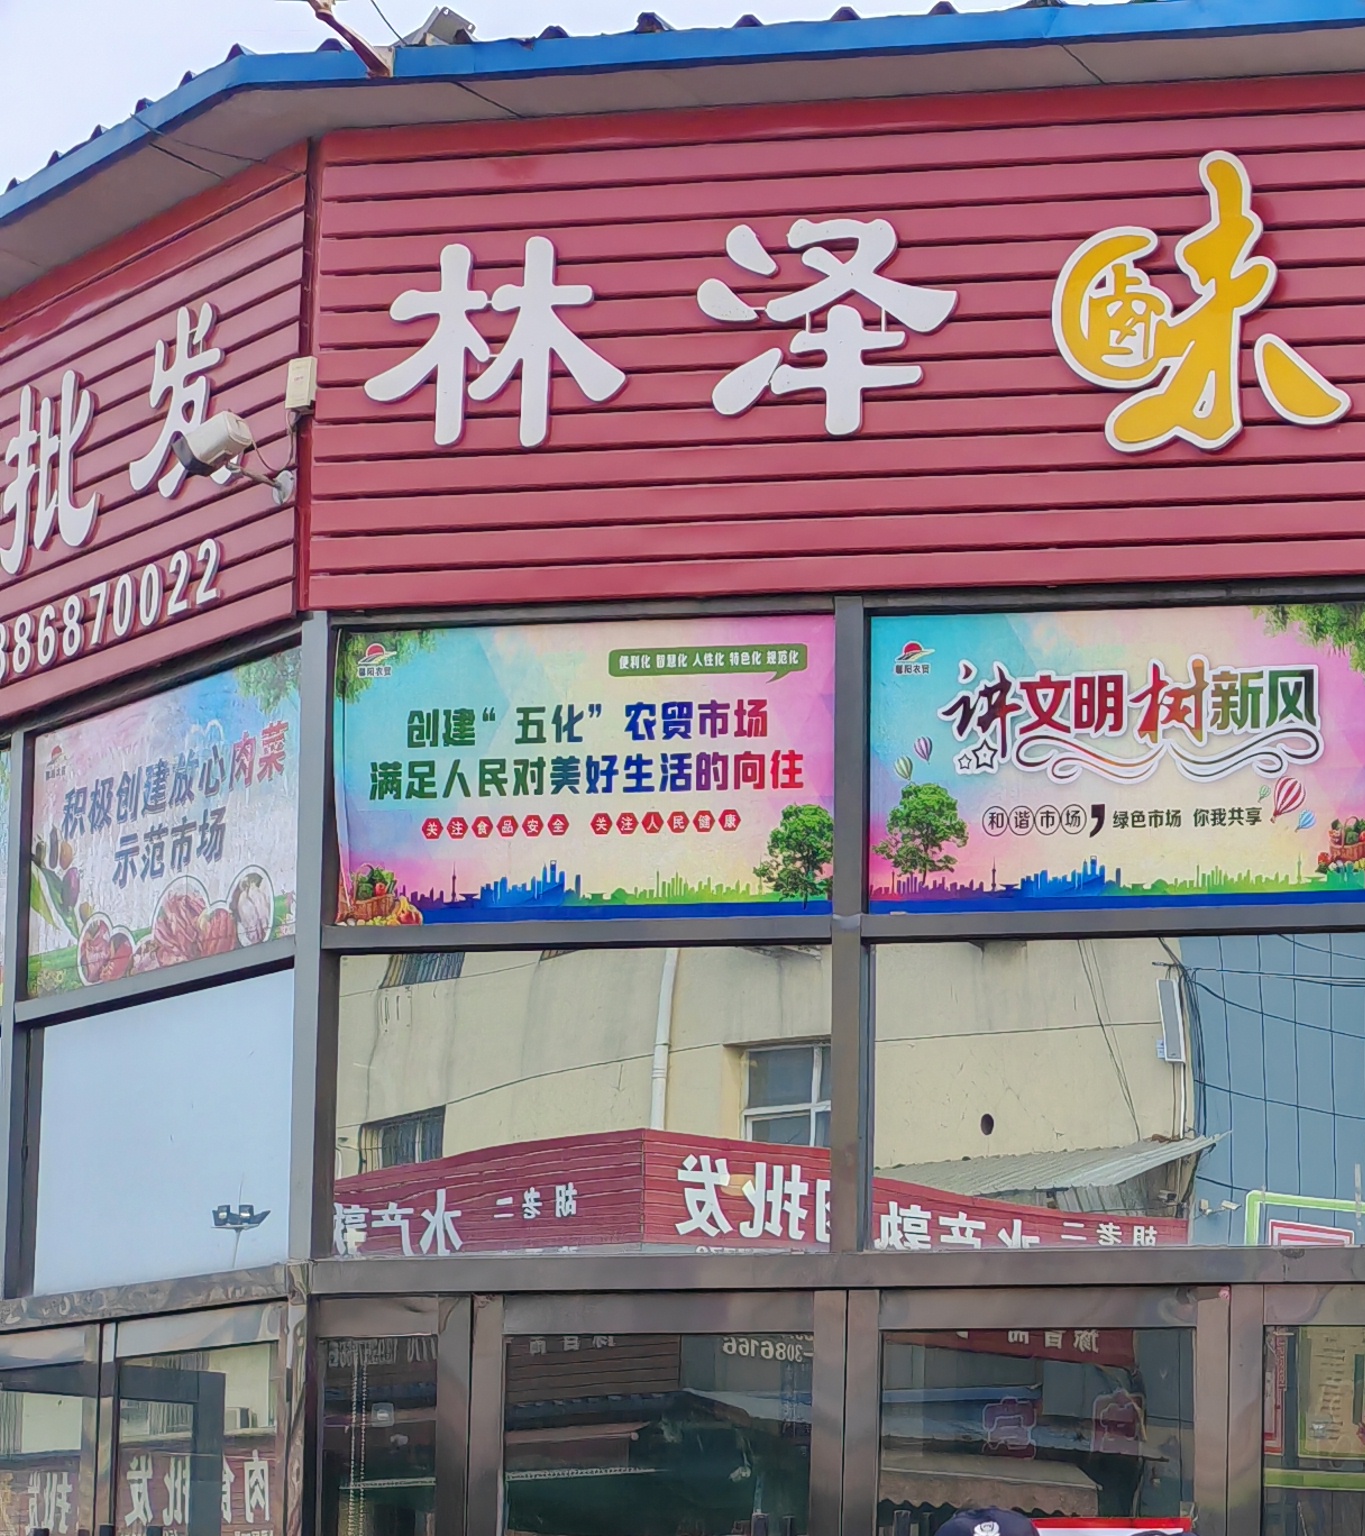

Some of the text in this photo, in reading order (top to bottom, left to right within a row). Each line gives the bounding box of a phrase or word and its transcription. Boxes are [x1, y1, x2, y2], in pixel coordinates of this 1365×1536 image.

[0, 302, 246, 576] 批发
[618, 649, 799, 671] 便利化 智慧化 人性化 特色化 规范化
[941, 660, 1319, 758] 讲文明树新风
[61, 720, 290, 841] 积极创建放心肉菜
[370, 748, 804, 801] 满足人民对美好生活的向往
[112, 805, 228, 889] 示范市场
[424, 811, 739, 838] 关注食品安全 关注人民健康
[1193, 806, 1263, 828] 你我共享
